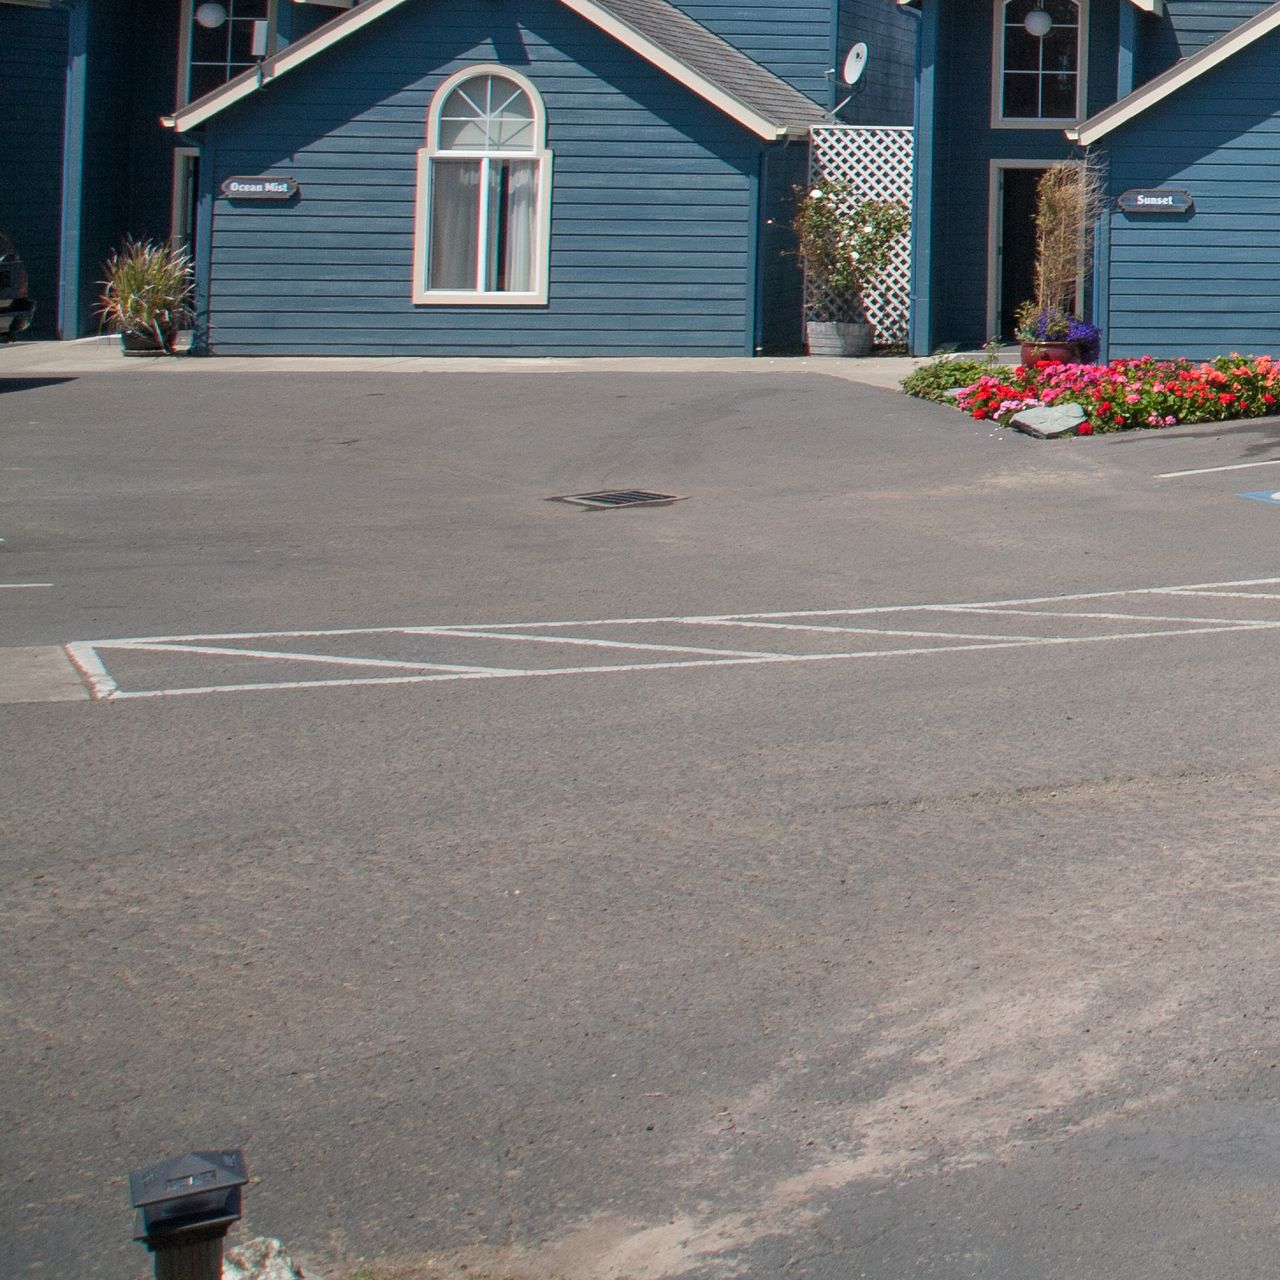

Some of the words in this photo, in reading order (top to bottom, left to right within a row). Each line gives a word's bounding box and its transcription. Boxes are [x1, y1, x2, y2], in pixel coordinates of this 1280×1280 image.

[230, 182, 263, 192] Ocean
[264, 182, 289, 192] Mist
[1136, 194, 1174, 205] Sunset
